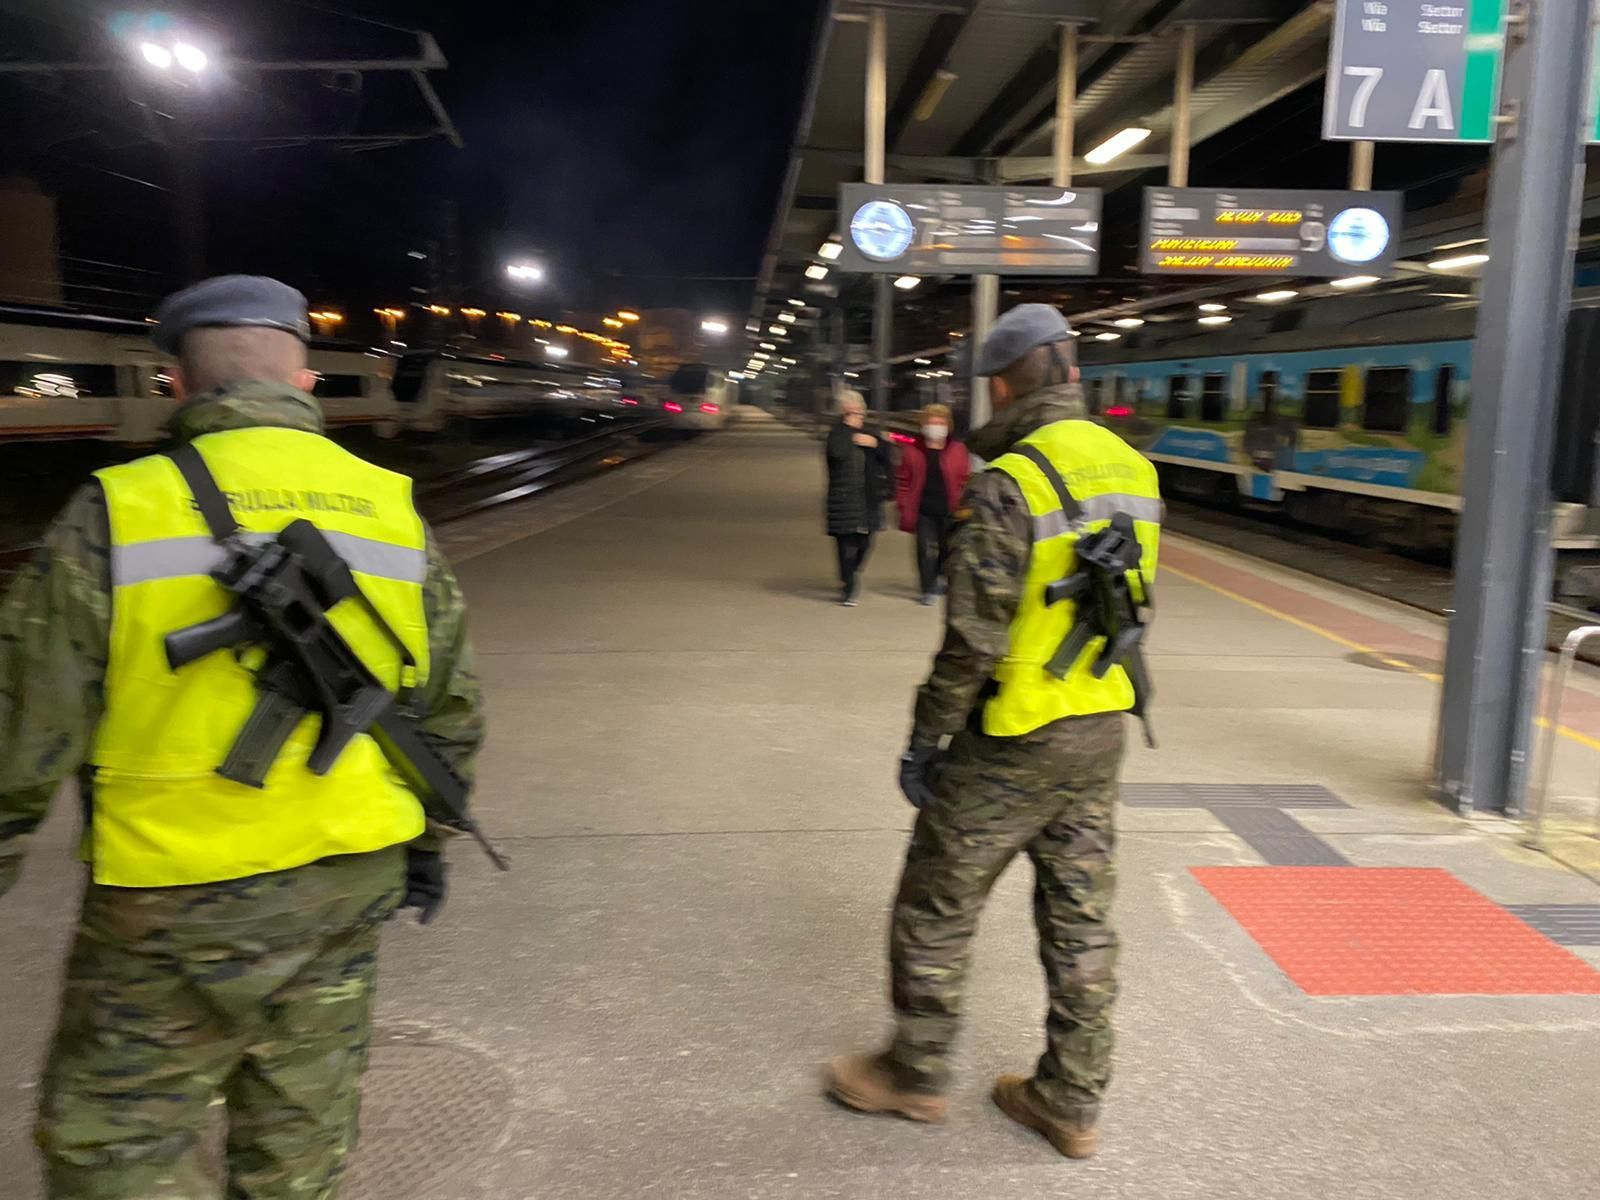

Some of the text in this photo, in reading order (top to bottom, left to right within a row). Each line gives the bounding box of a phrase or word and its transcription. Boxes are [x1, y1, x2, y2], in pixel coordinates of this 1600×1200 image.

[1344, 66, 1383, 128] 7
[1407, 69, 1454, 130] A
[1300, 221, 1325, 252] 9
